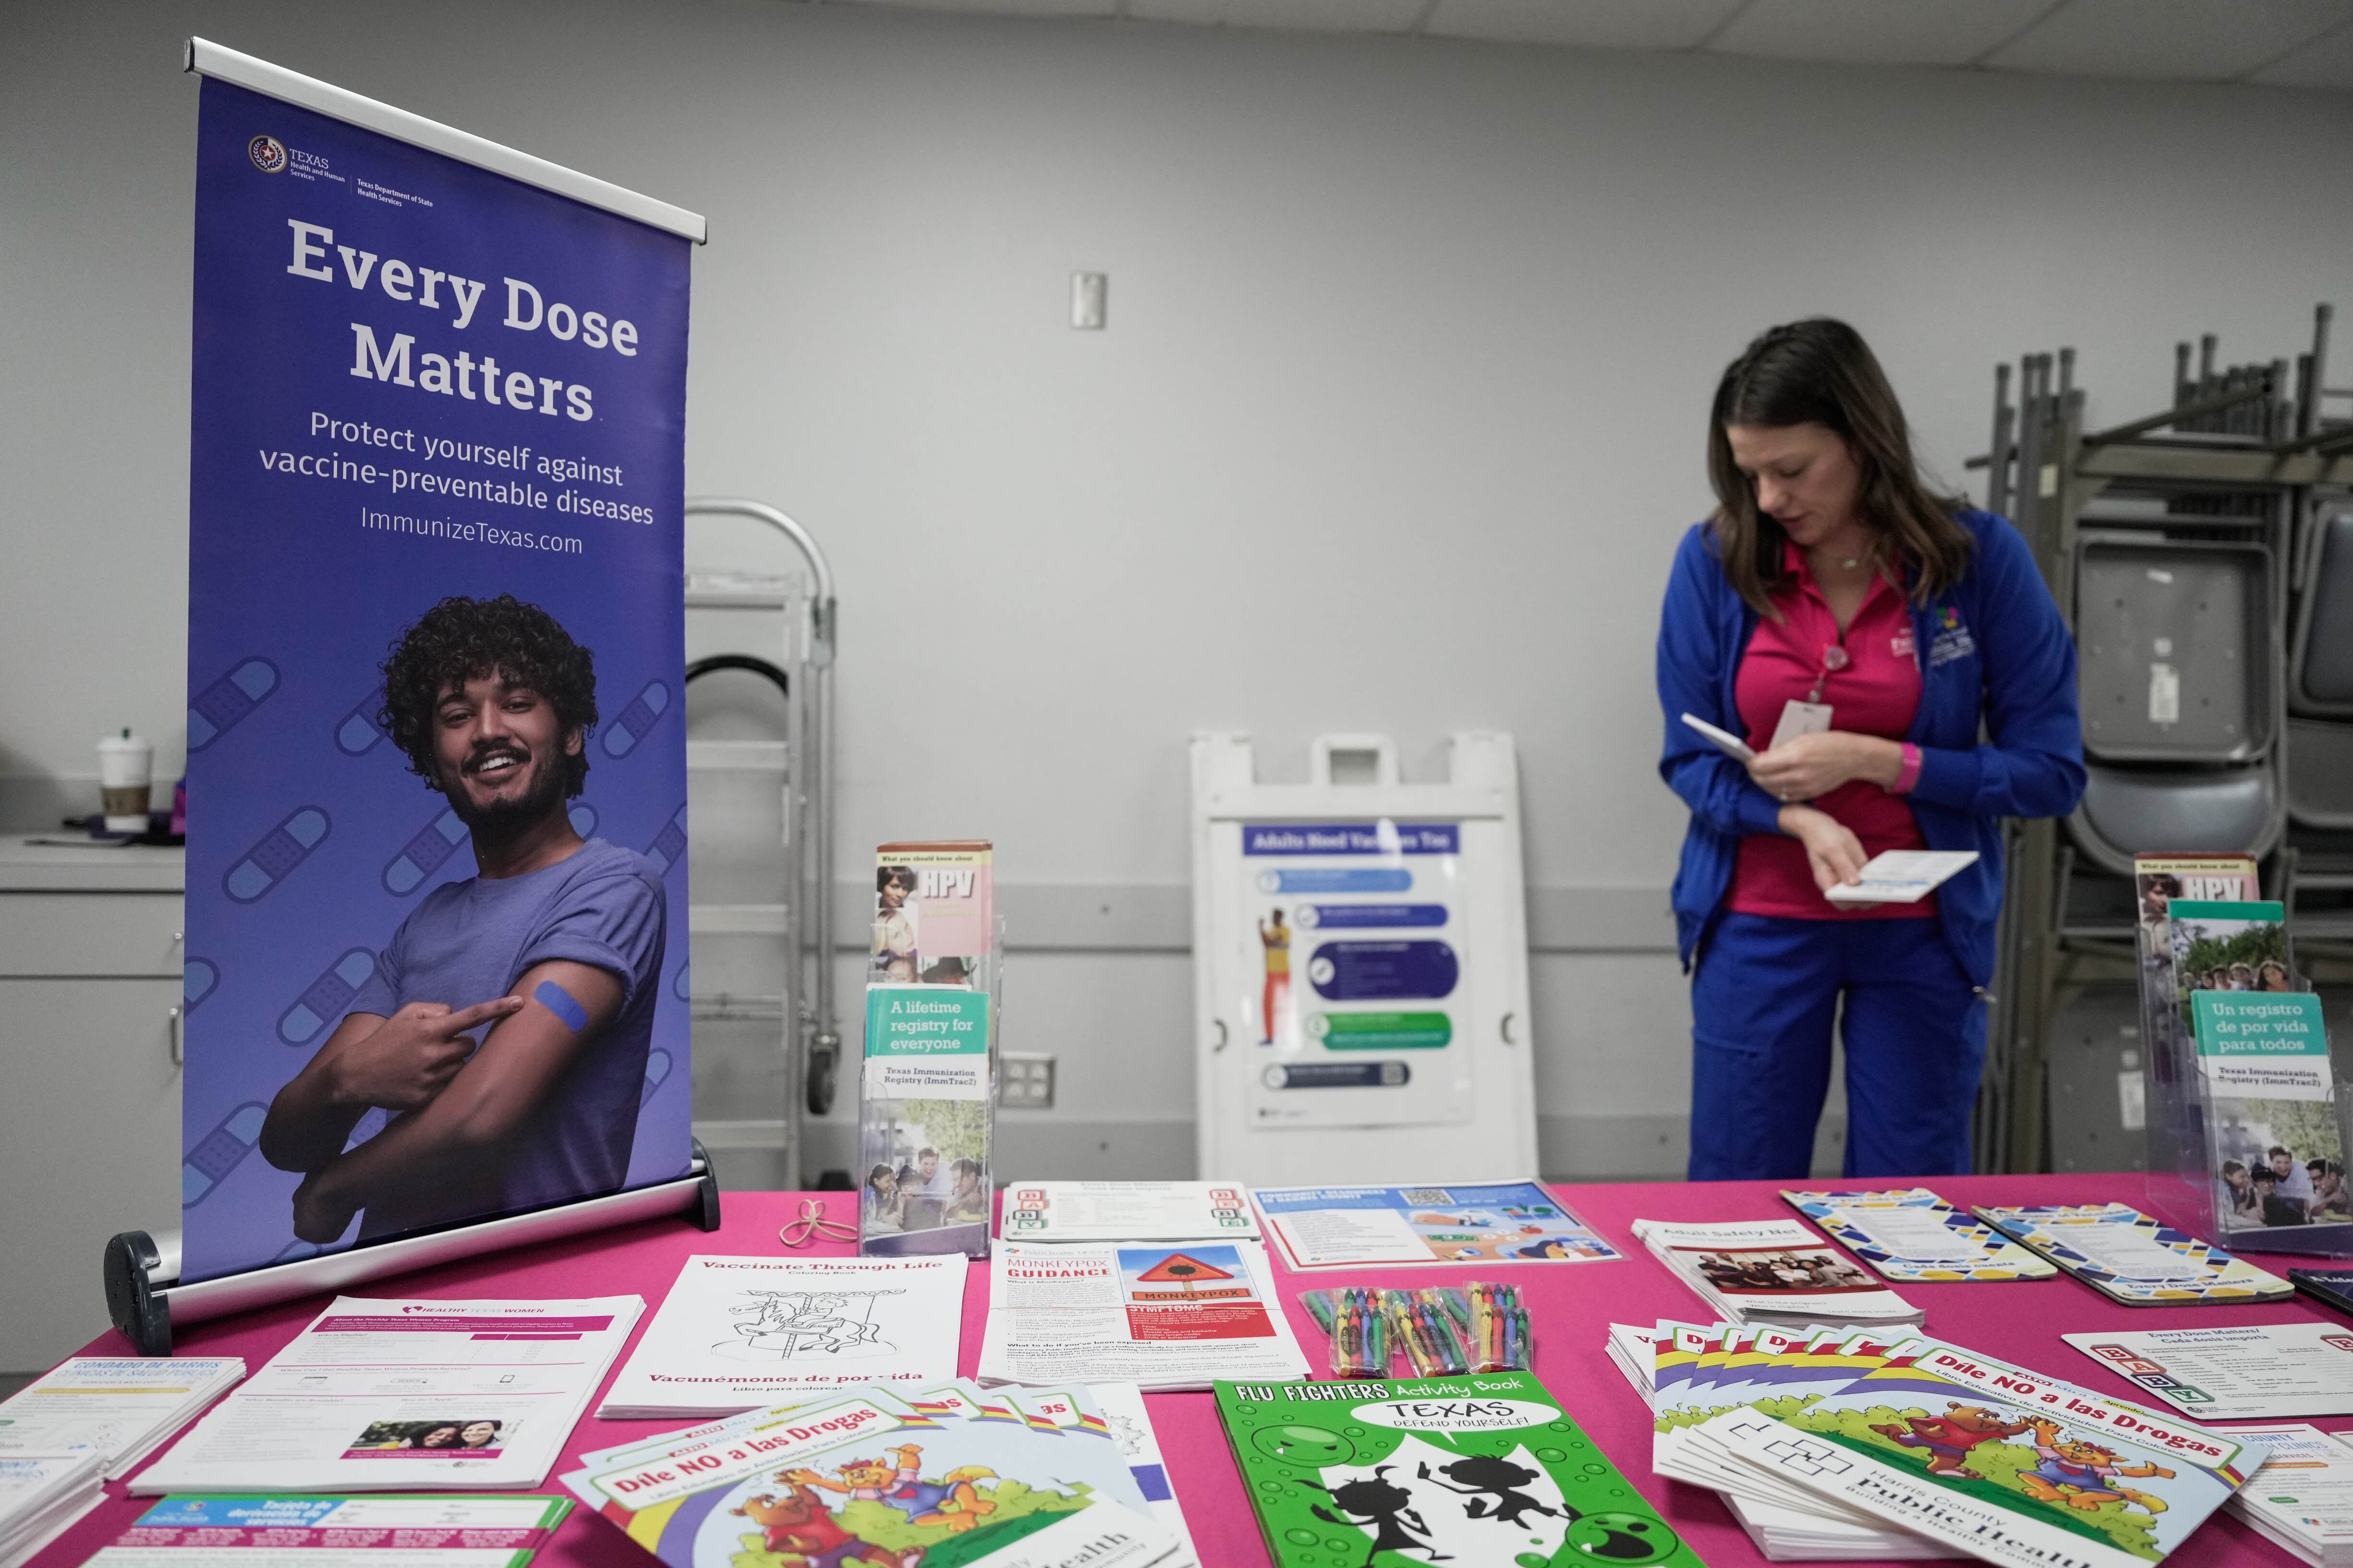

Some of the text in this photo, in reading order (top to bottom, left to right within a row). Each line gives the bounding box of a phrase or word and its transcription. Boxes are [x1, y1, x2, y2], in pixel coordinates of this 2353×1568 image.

[289, 148, 329, 169] TEXAS
[291, 161, 345, 182] Health and Human
[291, 169, 315, 181] Services
[357, 178, 433, 208] Texas Department of State
[358, 188, 402, 207] Health Services
[287, 218, 639, 356] Every Dose
[351, 322, 594, 422] Matters
[311, 411, 623, 486] Protect yourself against
[259, 447, 654, 525] vaccine-preventable diseases
[361, 507, 583, 554] ImmunizeTexas.com
[921, 869, 974, 898] HPV
[2186, 877, 2243, 901] HPV
[890, 1001, 961, 1013] A lifetime
[2212, 1003, 2303, 1019] Un registro
[891, 1019, 974, 1035] registry for
[2216, 1021, 2310, 1036] de por vida
[890, 1039, 961, 1052] everyone
[2219, 1038, 2305, 1053] para todos
[884, 1076, 977, 1086] Registry (ImmTrac2)
[913, 1068, 976, 1076] Immunization
[2219, 1067, 2318, 1077] Texas Immunization
[703, 1262, 804, 1271] Vaccinate
[809, 1263, 897, 1273] Through
[1008, 1259, 1108, 1267] MONKEYPOX
[1008, 1268, 1111, 1277] GUIDANCE
[1145, 1291, 1239, 1299] MONKEYPOX
[649, 1374, 799, 1384] Vacunémonos
[805, 1375, 830, 1383] de
[837, 1375, 870, 1384] por
[1234, 1377, 1524, 1401] FLU FIGHTERS Activity Book
[2016, 1372, 2052, 1386] ALTO
[2103, 1399, 2143, 1414] Aprende
[1386, 1401, 1515, 1418] TEXAS
[1936, 1368, 2188, 1458] Libro Educativo de Actividades Para Colorear
[1992, 1375, 2036, 1394] NO
[2040, 1391, 2057, 1403] a
[2066, 1398, 2108, 1420] las
[2113, 1414, 2223, 1457] Drogas
[1393, 1416, 1531, 1428] DEFEND YOURSELF!
[675, 1454, 723, 1475] NO
[728, 1446, 747, 1460] a
[746, 1433, 790, 1454] las
[786, 1407, 878, 1441] Drogas
[2241, 1434, 2294, 1442] COUNTY
[2278, 1441, 2329, 1450] CLINICS
[649, 1489, 679, 1501] Libro
[681, 1472, 737, 1491] Educativo
[835, 1426, 877, 1443] Colorear
[1852, 1477, 1965, 1525] Public
[1870, 1469, 2008, 1526] Harris County
[1845, 1485, 1907, 1515] Building
[1927, 1519, 1989, 1548] Healthy
